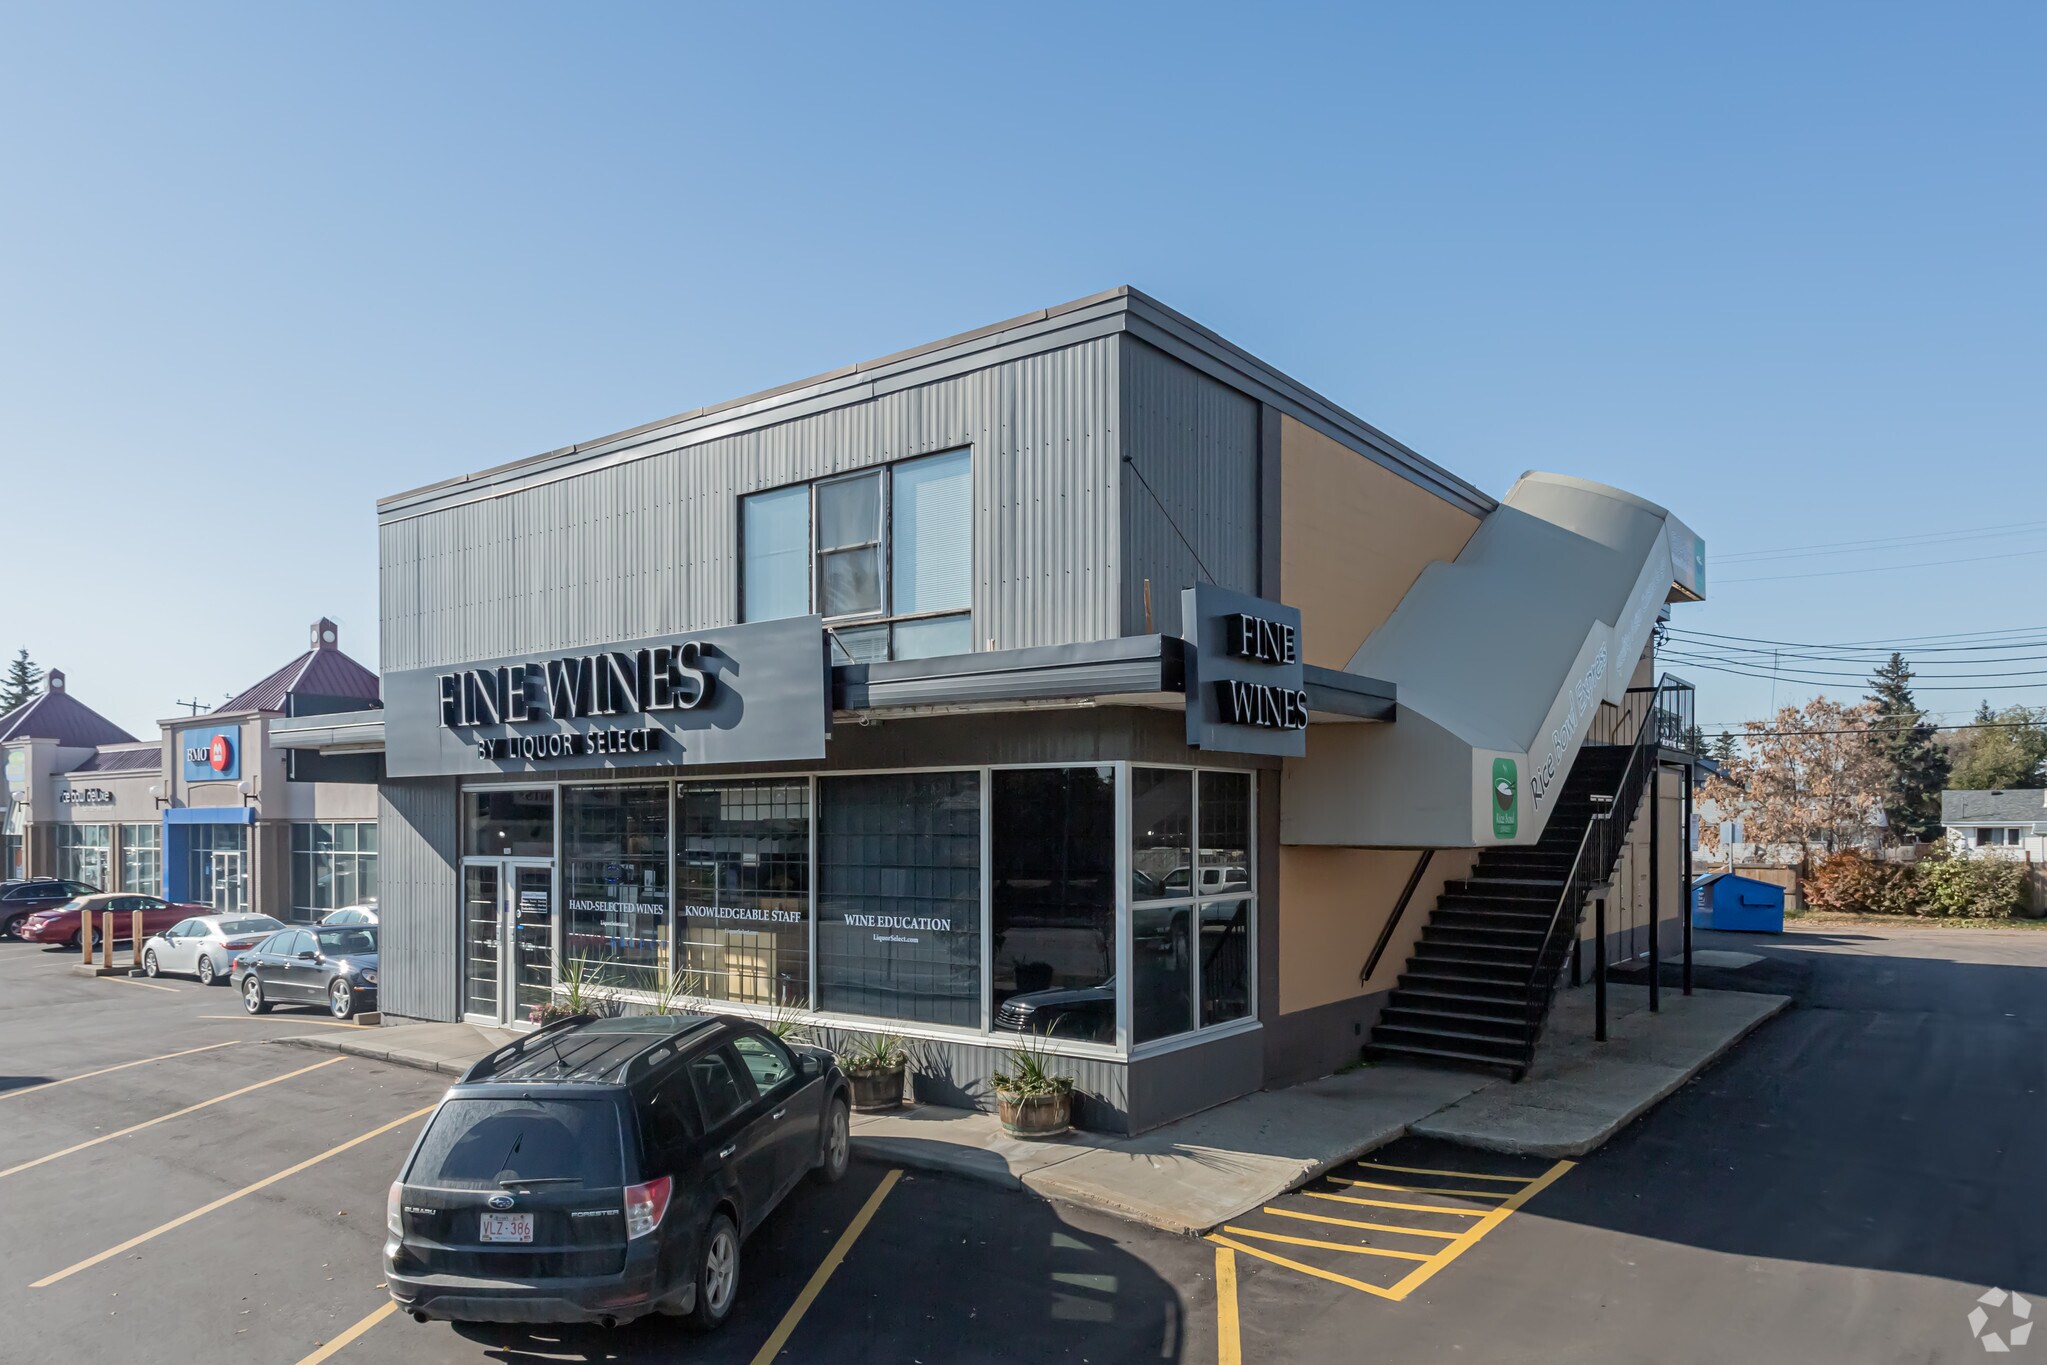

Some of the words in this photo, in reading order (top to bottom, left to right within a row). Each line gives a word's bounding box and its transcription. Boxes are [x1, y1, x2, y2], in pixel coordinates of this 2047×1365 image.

[1240, 613, 1295, 665] FINE
[435, 663, 529, 729] FINE
[540, 640, 706, 720] WINES
[1230, 680, 1309, 730] WINES
[1530, 752, 1556, 812] Rice
[1551, 689, 1579, 763] Bowl
[1575, 641, 1608, 718] Express
[186, 746, 208, 762] BMO
[477, 738, 497, 760] BY
[509, 733, 574, 761] LIQUOR
[586, 728, 651, 755] SELECT
[568, 899, 635, 914] HAND-SELECTED
[636, 902, 664, 916] WINES
[684, 904, 770, 921] KNOWLEDGEABLE
[771, 909, 802, 923] STAFF
[843, 913, 878, 927] WINE
[877, 915, 951, 932] EDUCATION
[872, 933, 919, 944] LiquorSelect.com
[571, 1209, 620, 1218] FORESTER
